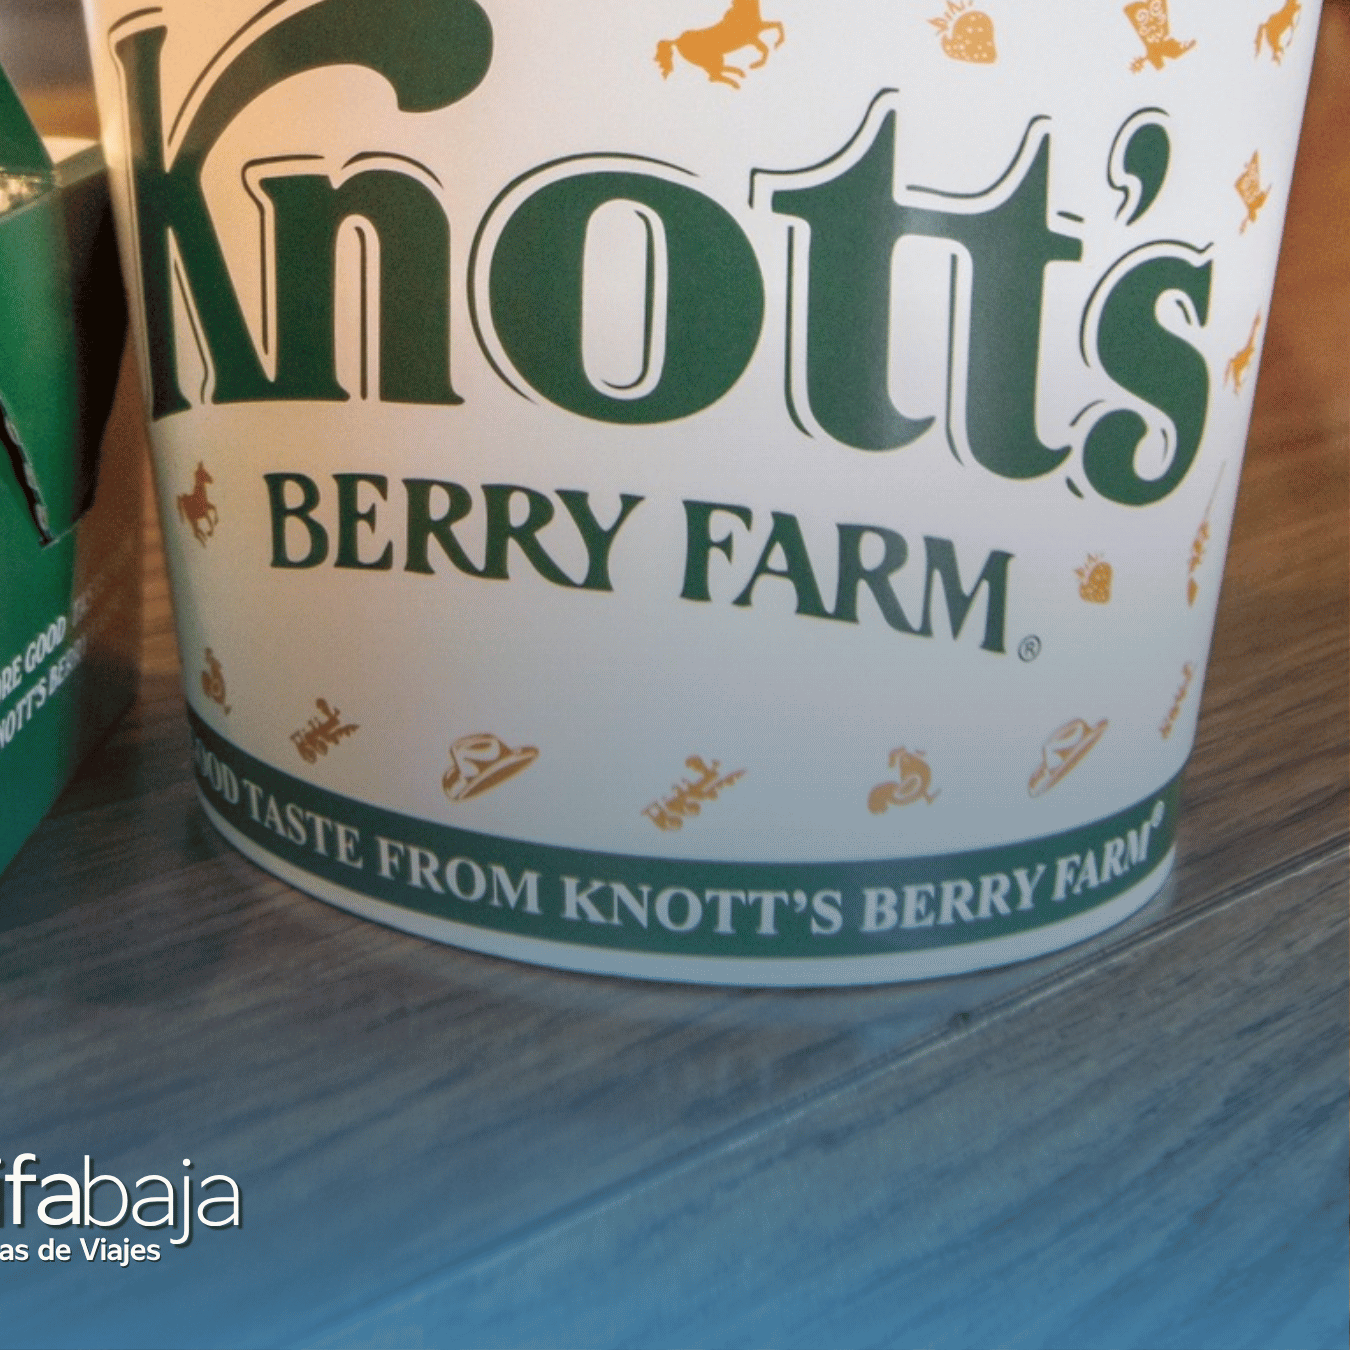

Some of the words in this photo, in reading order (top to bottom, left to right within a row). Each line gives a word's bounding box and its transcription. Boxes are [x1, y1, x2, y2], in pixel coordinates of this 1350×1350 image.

[262, 471, 645, 595] BERRY
[24, 615, 67, 674] GOOD
[241, 778, 364, 870] TASTE
[375, 835, 544, 916] FROM
[560, 874, 844, 936] KNOTT'S
[860, 863, 1046, 934] BERRY
